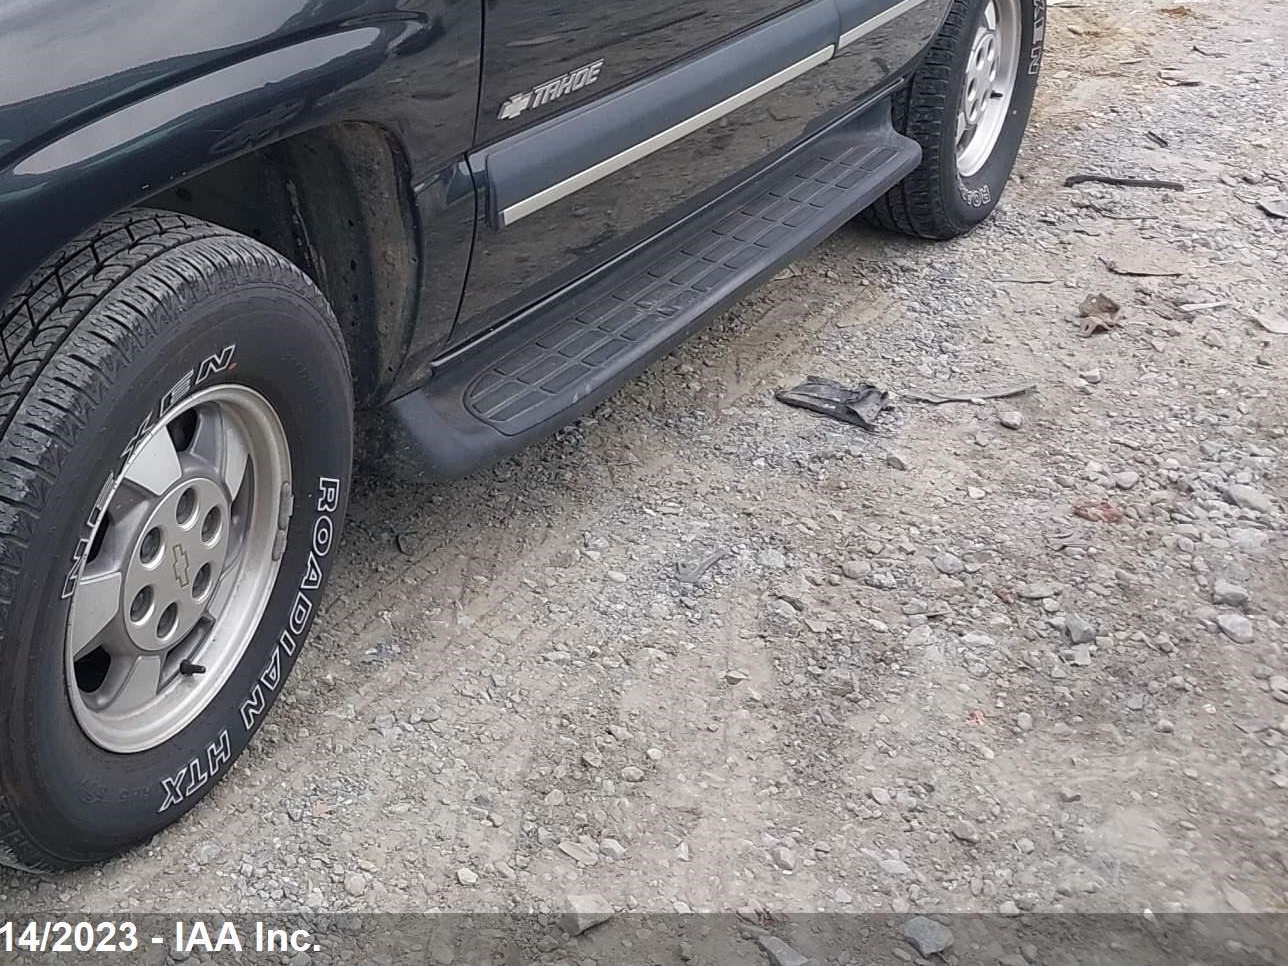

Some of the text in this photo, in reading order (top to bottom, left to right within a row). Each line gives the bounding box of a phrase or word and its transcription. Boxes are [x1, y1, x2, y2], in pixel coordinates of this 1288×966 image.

[532, 58, 604, 108] TAHOE
[241, 477, 340, 730] ROADIAN
[158, 730, 231, 813] HTX
